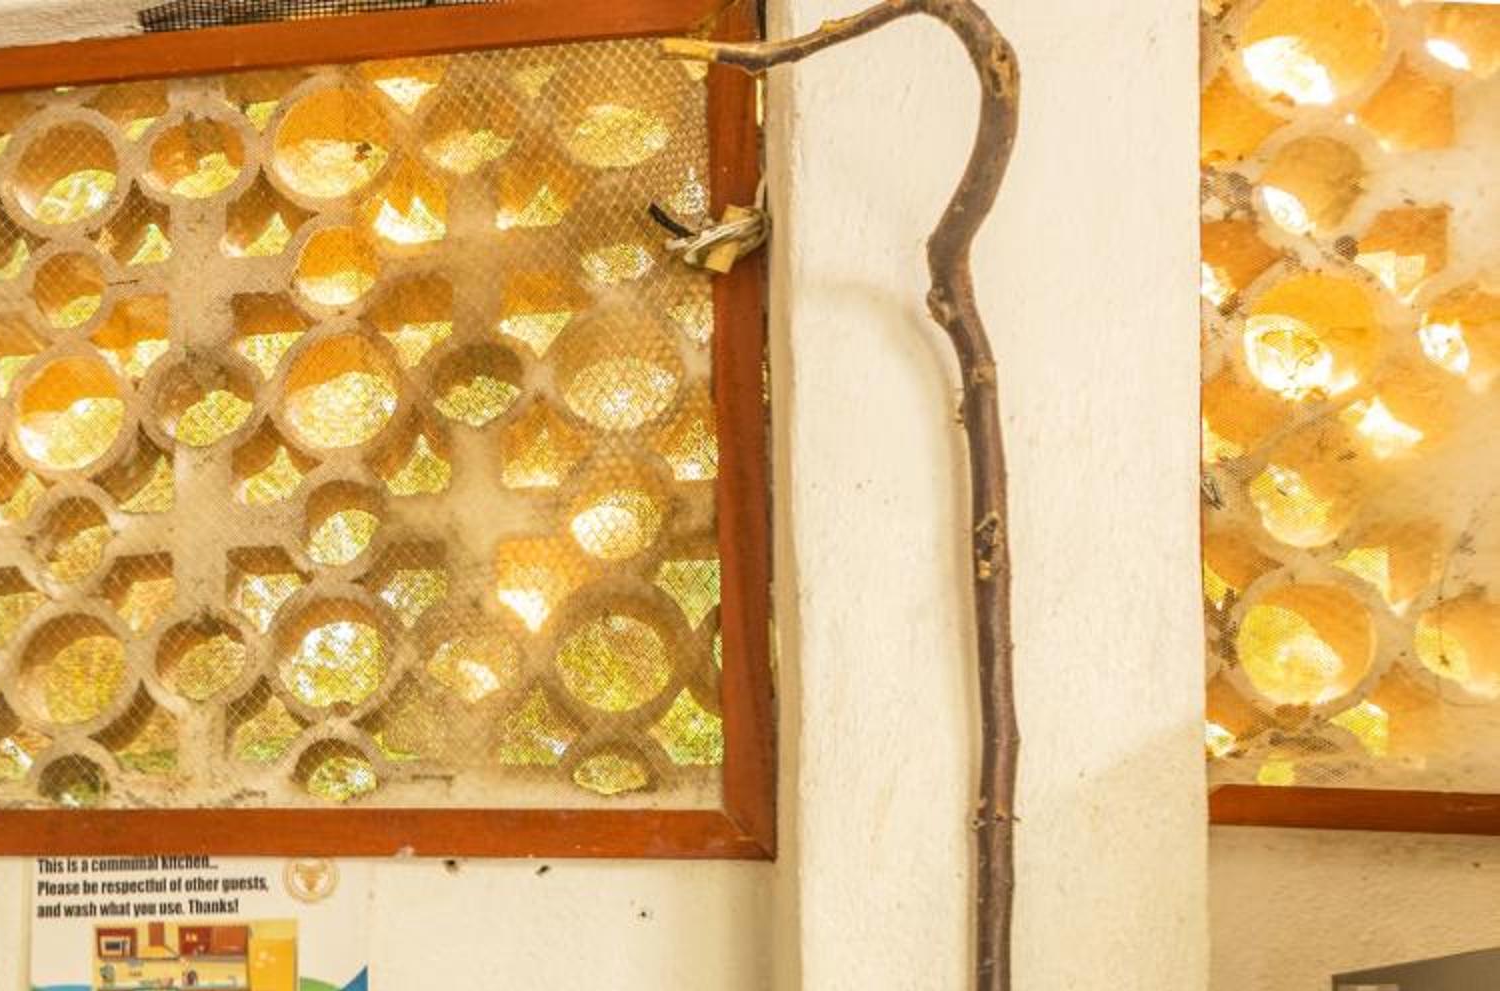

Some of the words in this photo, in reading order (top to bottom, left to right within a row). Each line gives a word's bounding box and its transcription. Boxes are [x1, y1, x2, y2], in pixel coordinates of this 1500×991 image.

[37, 858, 63, 873] This
[67, 857, 78, 872] is
[81, 859, 89, 872] a
[91, 855, 158, 871] communal
[37, 881, 80, 896] Please
[83, 880, 98, 894] be
[101, 878, 166, 894] respectful
[169, 877, 181, 892] of
[185, 876, 218, 892] other
[221, 876, 269, 893] guests,
[37, 902, 60, 917] and
[63, 901, 97, 917] wash
[100, 900, 130, 916] what
[133, 902, 156, 917] you
[159, 901, 185, 915] use.
[188, 898, 239, 914] Thanks!
